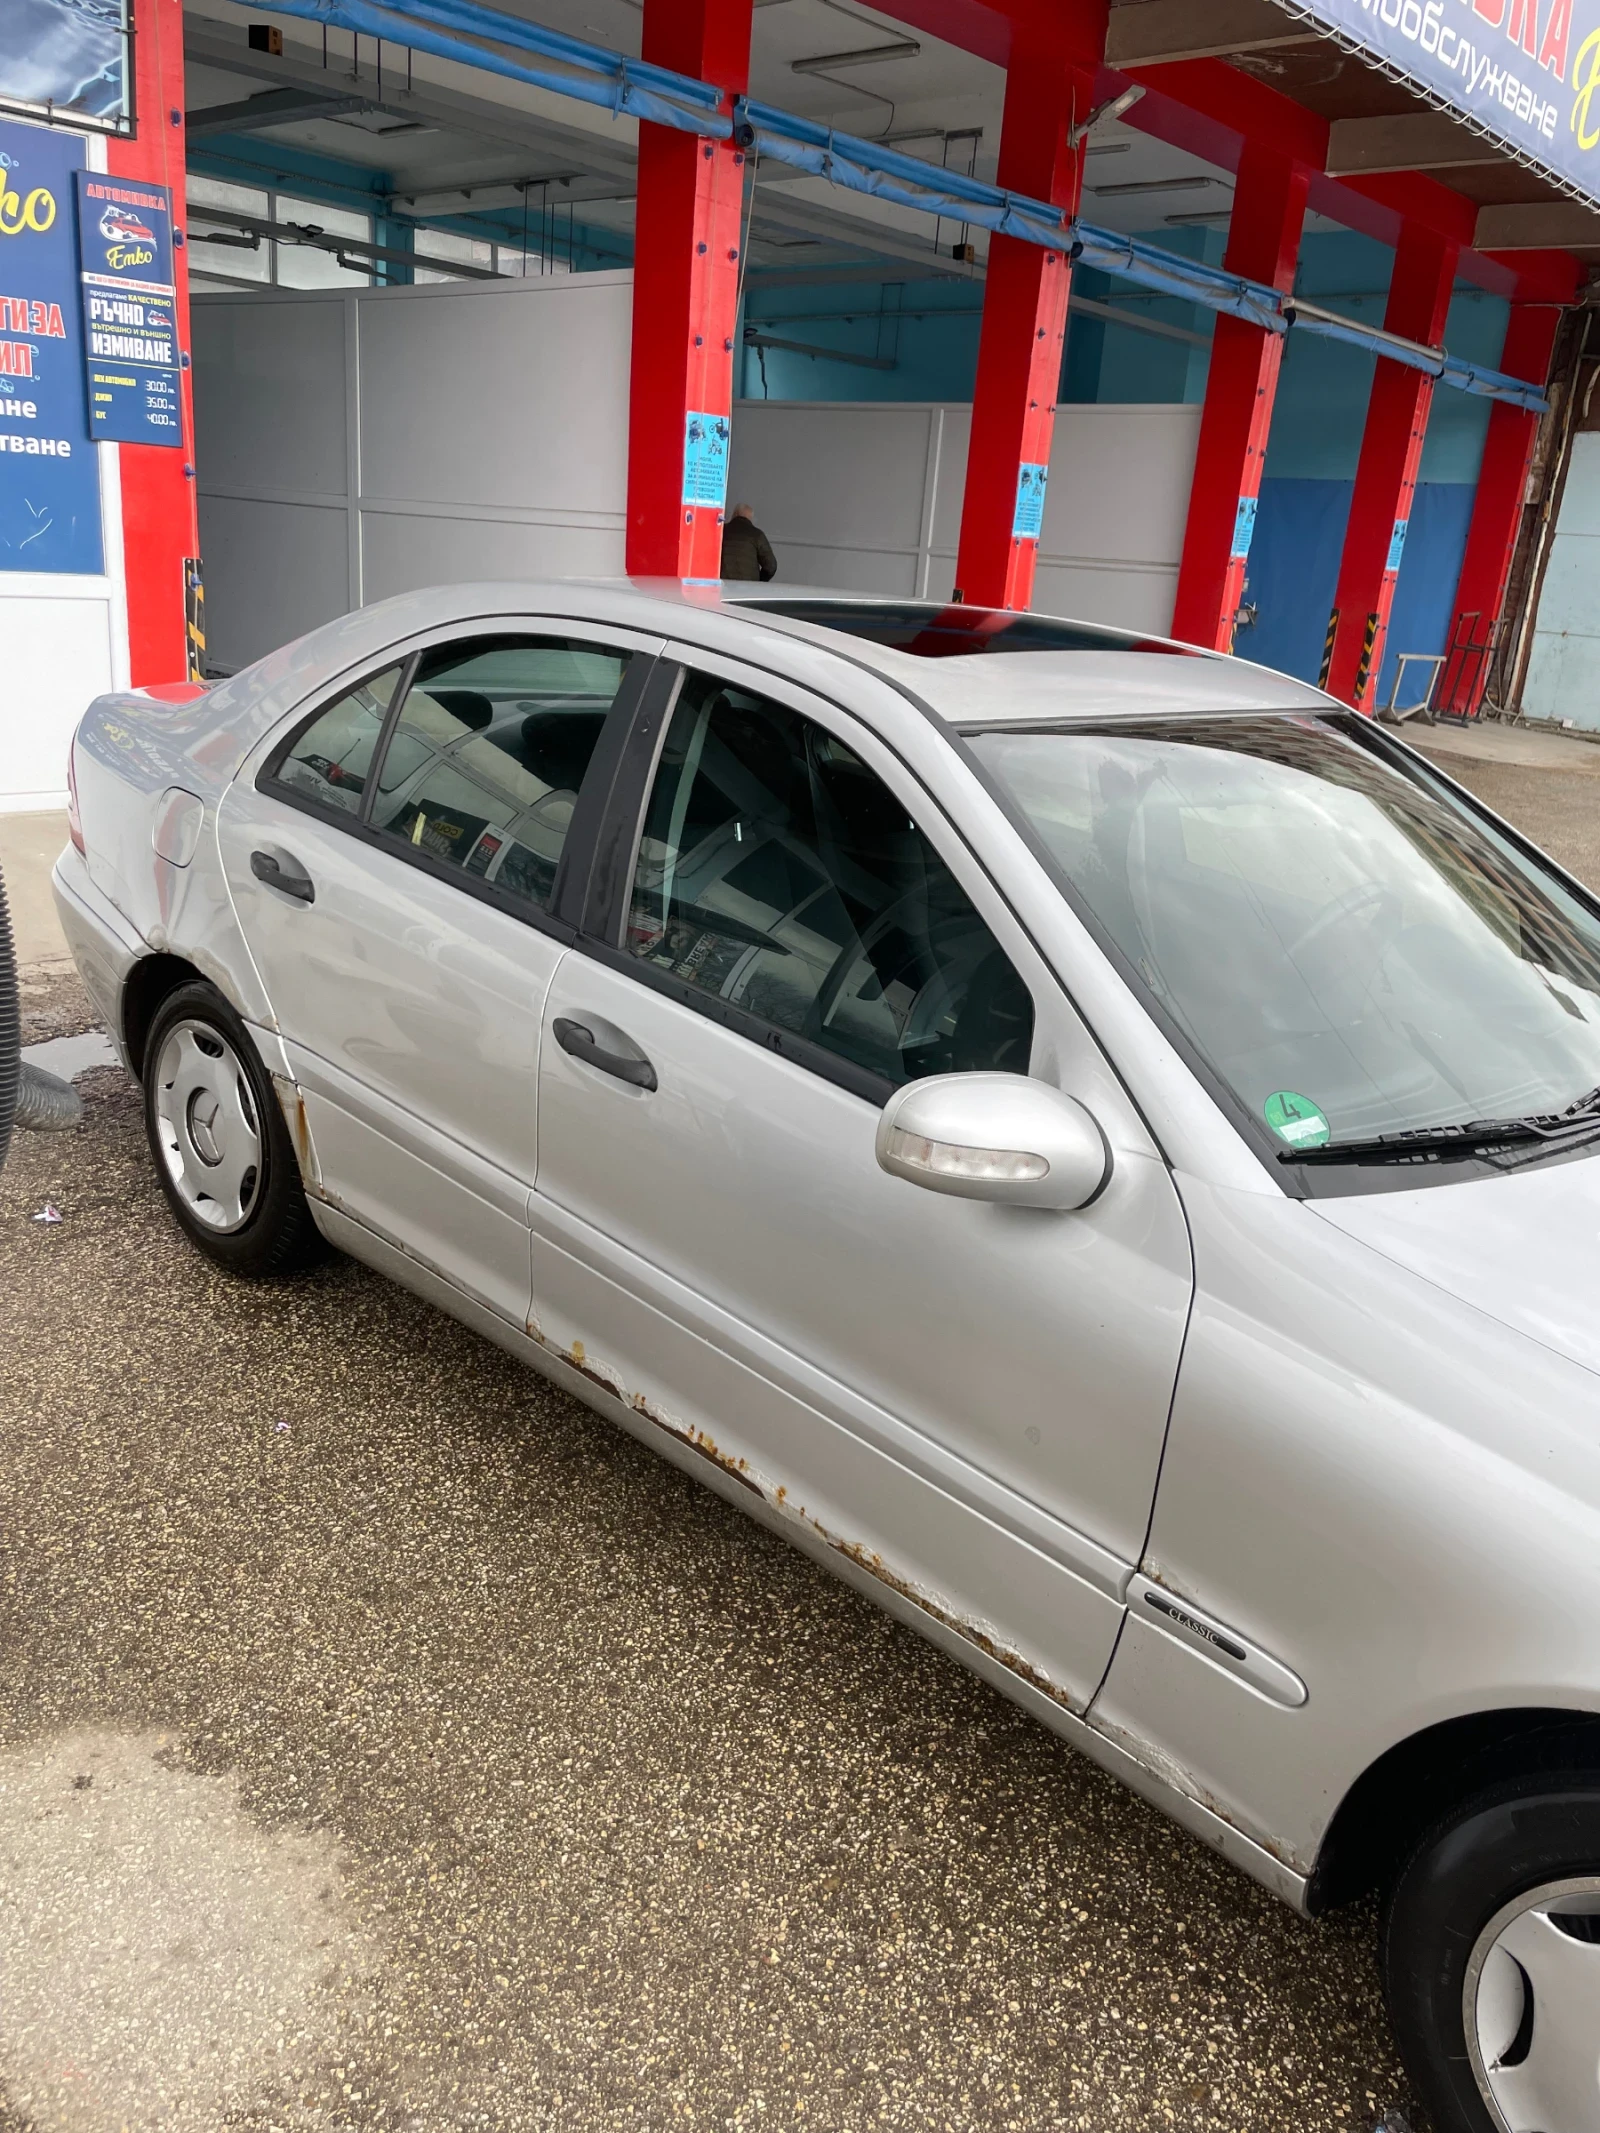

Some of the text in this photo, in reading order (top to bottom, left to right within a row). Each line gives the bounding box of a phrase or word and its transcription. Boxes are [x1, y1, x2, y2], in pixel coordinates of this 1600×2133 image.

[86, 183, 166, 211] АВТОМИВКА
[90, 298, 144, 326] РЪЧНО
[128, 294, 171, 307] КАЧЕСТВЕНО
[91, 323, 132, 334] вътрешно
[140, 330, 171, 340] външно
[92, 332, 172, 363] ИЗМИВАНЕ
[1279, 1094, 1302, 1119] 4
[1168, 1606, 1219, 1644] CLASSIC
